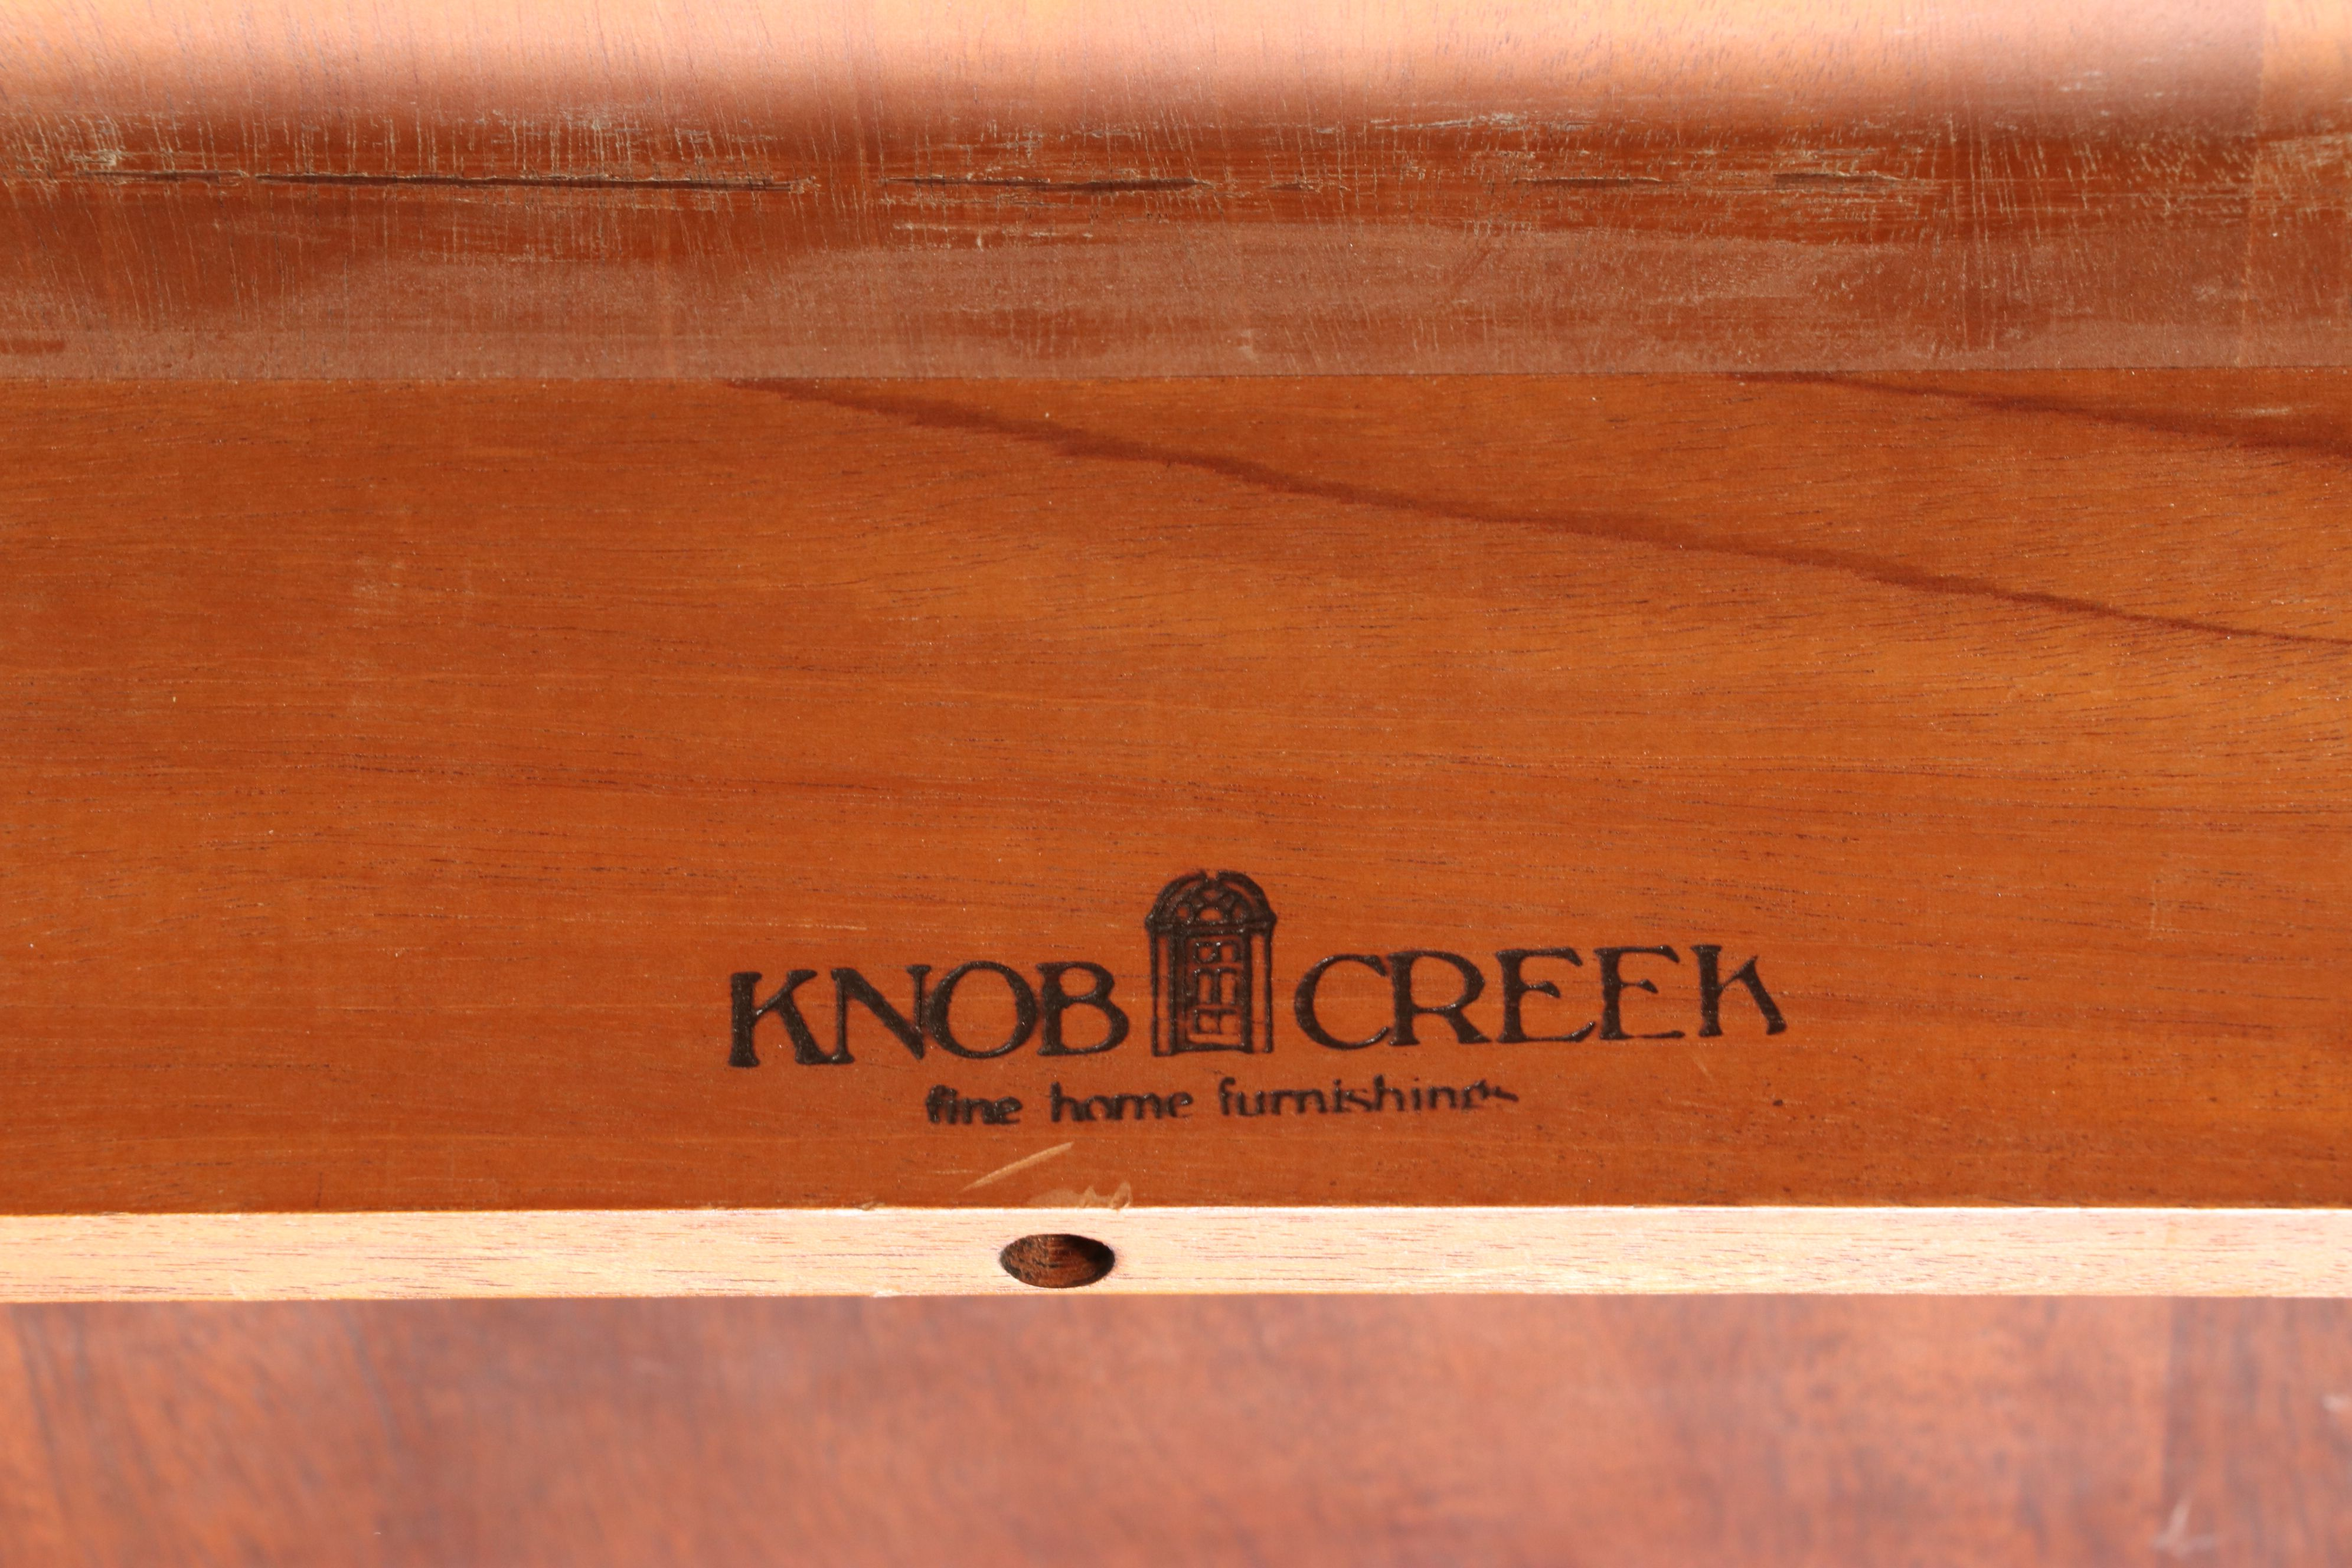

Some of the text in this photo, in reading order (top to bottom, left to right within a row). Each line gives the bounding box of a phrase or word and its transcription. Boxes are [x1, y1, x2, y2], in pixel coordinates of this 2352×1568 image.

[729, 945, 1787, 1066] KNOB CREEK
[926, 1083, 1023, 1125] fine
[1050, 1081, 1193, 1123] home
